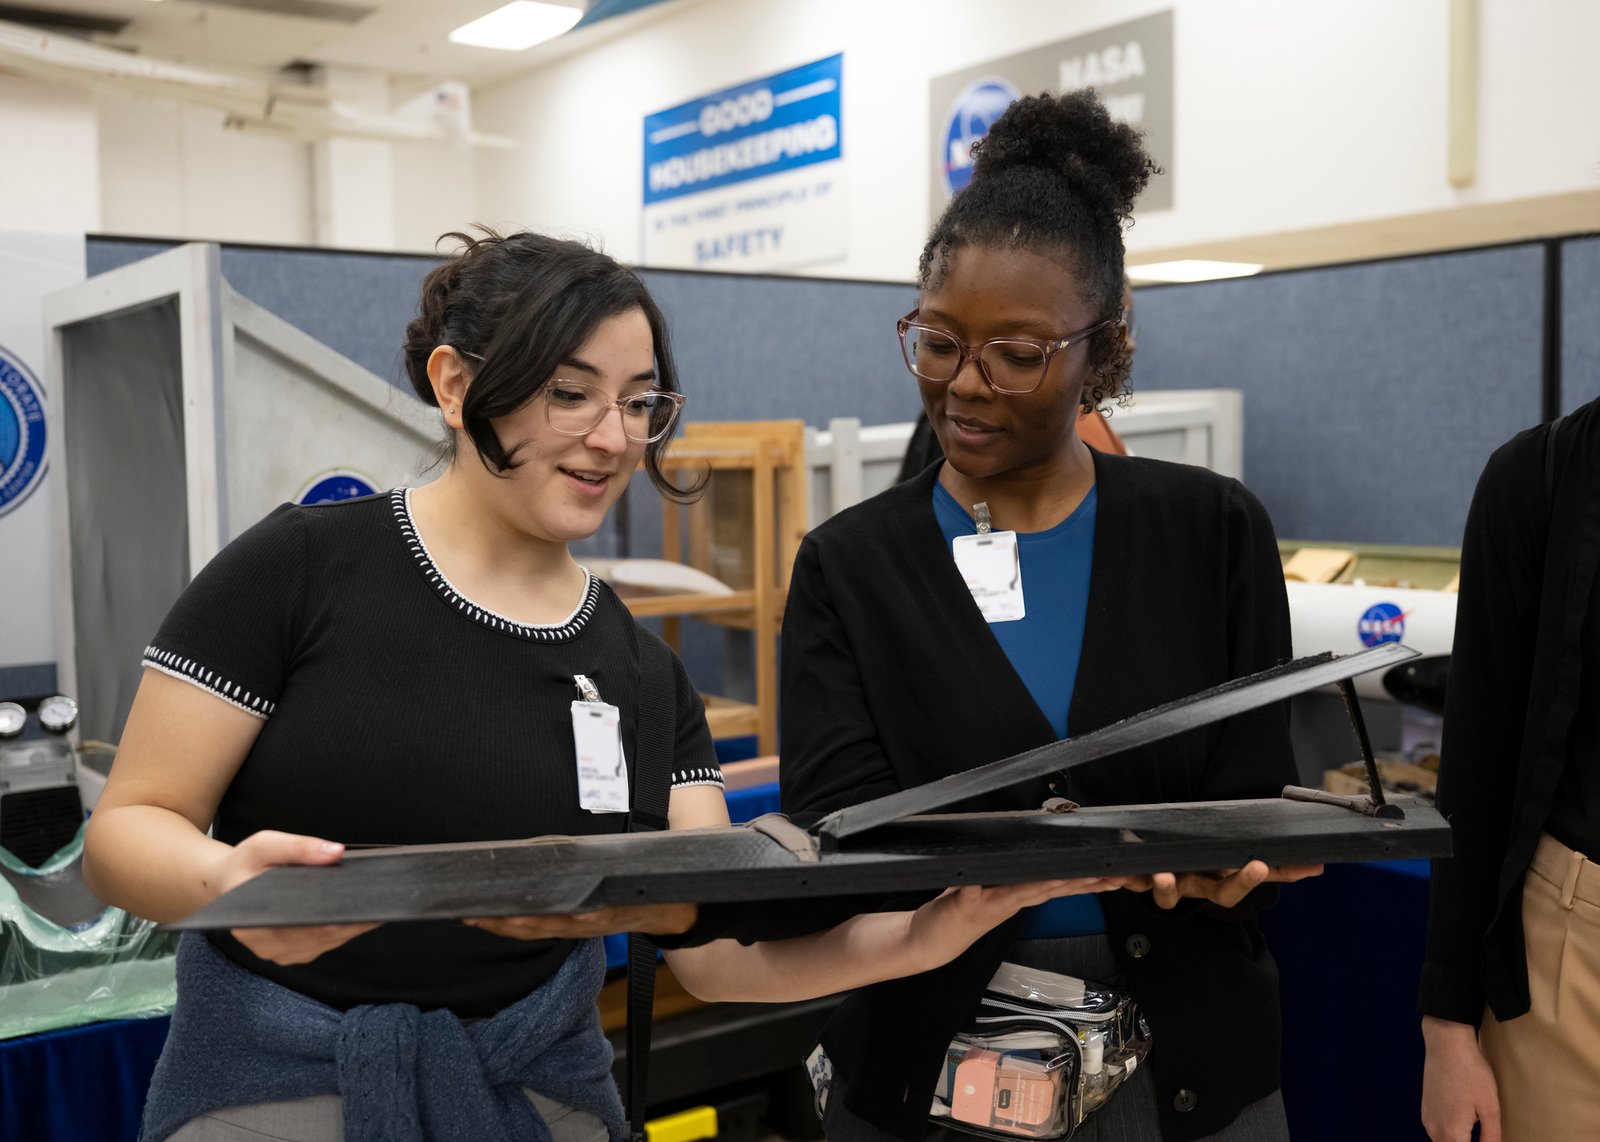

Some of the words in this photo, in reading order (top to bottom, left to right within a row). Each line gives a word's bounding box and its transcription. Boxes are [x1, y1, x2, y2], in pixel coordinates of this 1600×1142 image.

[1058, 41, 1146, 92] NASA
[699, 87, 772, 137] GOOD
[650, 114, 837, 191] HOUSEKEEPING
[695, 227, 785, 262] SAFETY
